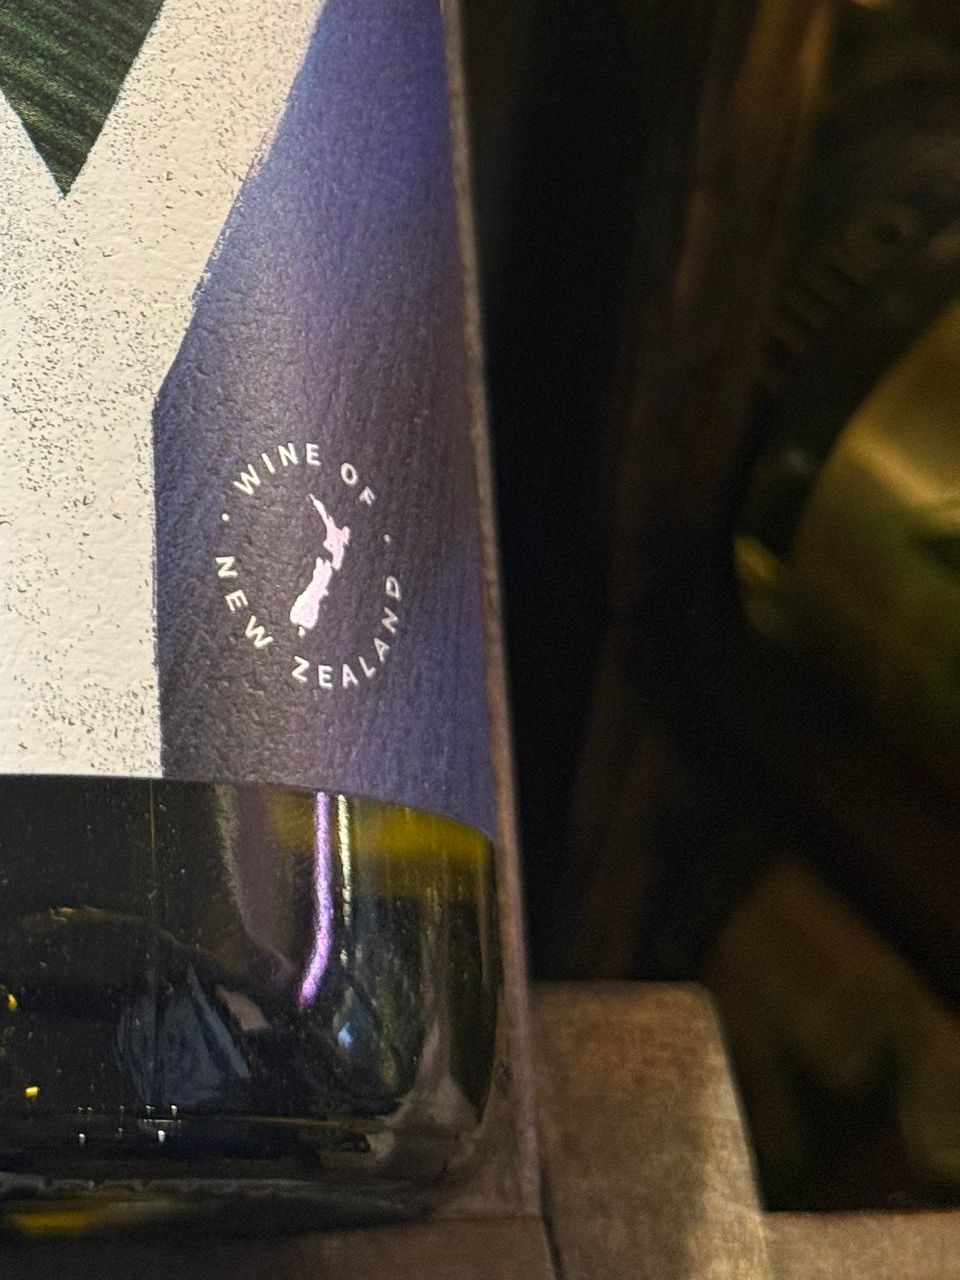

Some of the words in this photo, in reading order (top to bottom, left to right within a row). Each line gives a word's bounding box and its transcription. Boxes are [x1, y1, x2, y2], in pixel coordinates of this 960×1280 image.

[233, 442, 322, 496] WINE
[340, 462, 376, 505] OF
[214, 555, 274, 650] NEW
[291, 575, 402, 690] ZEALAND
